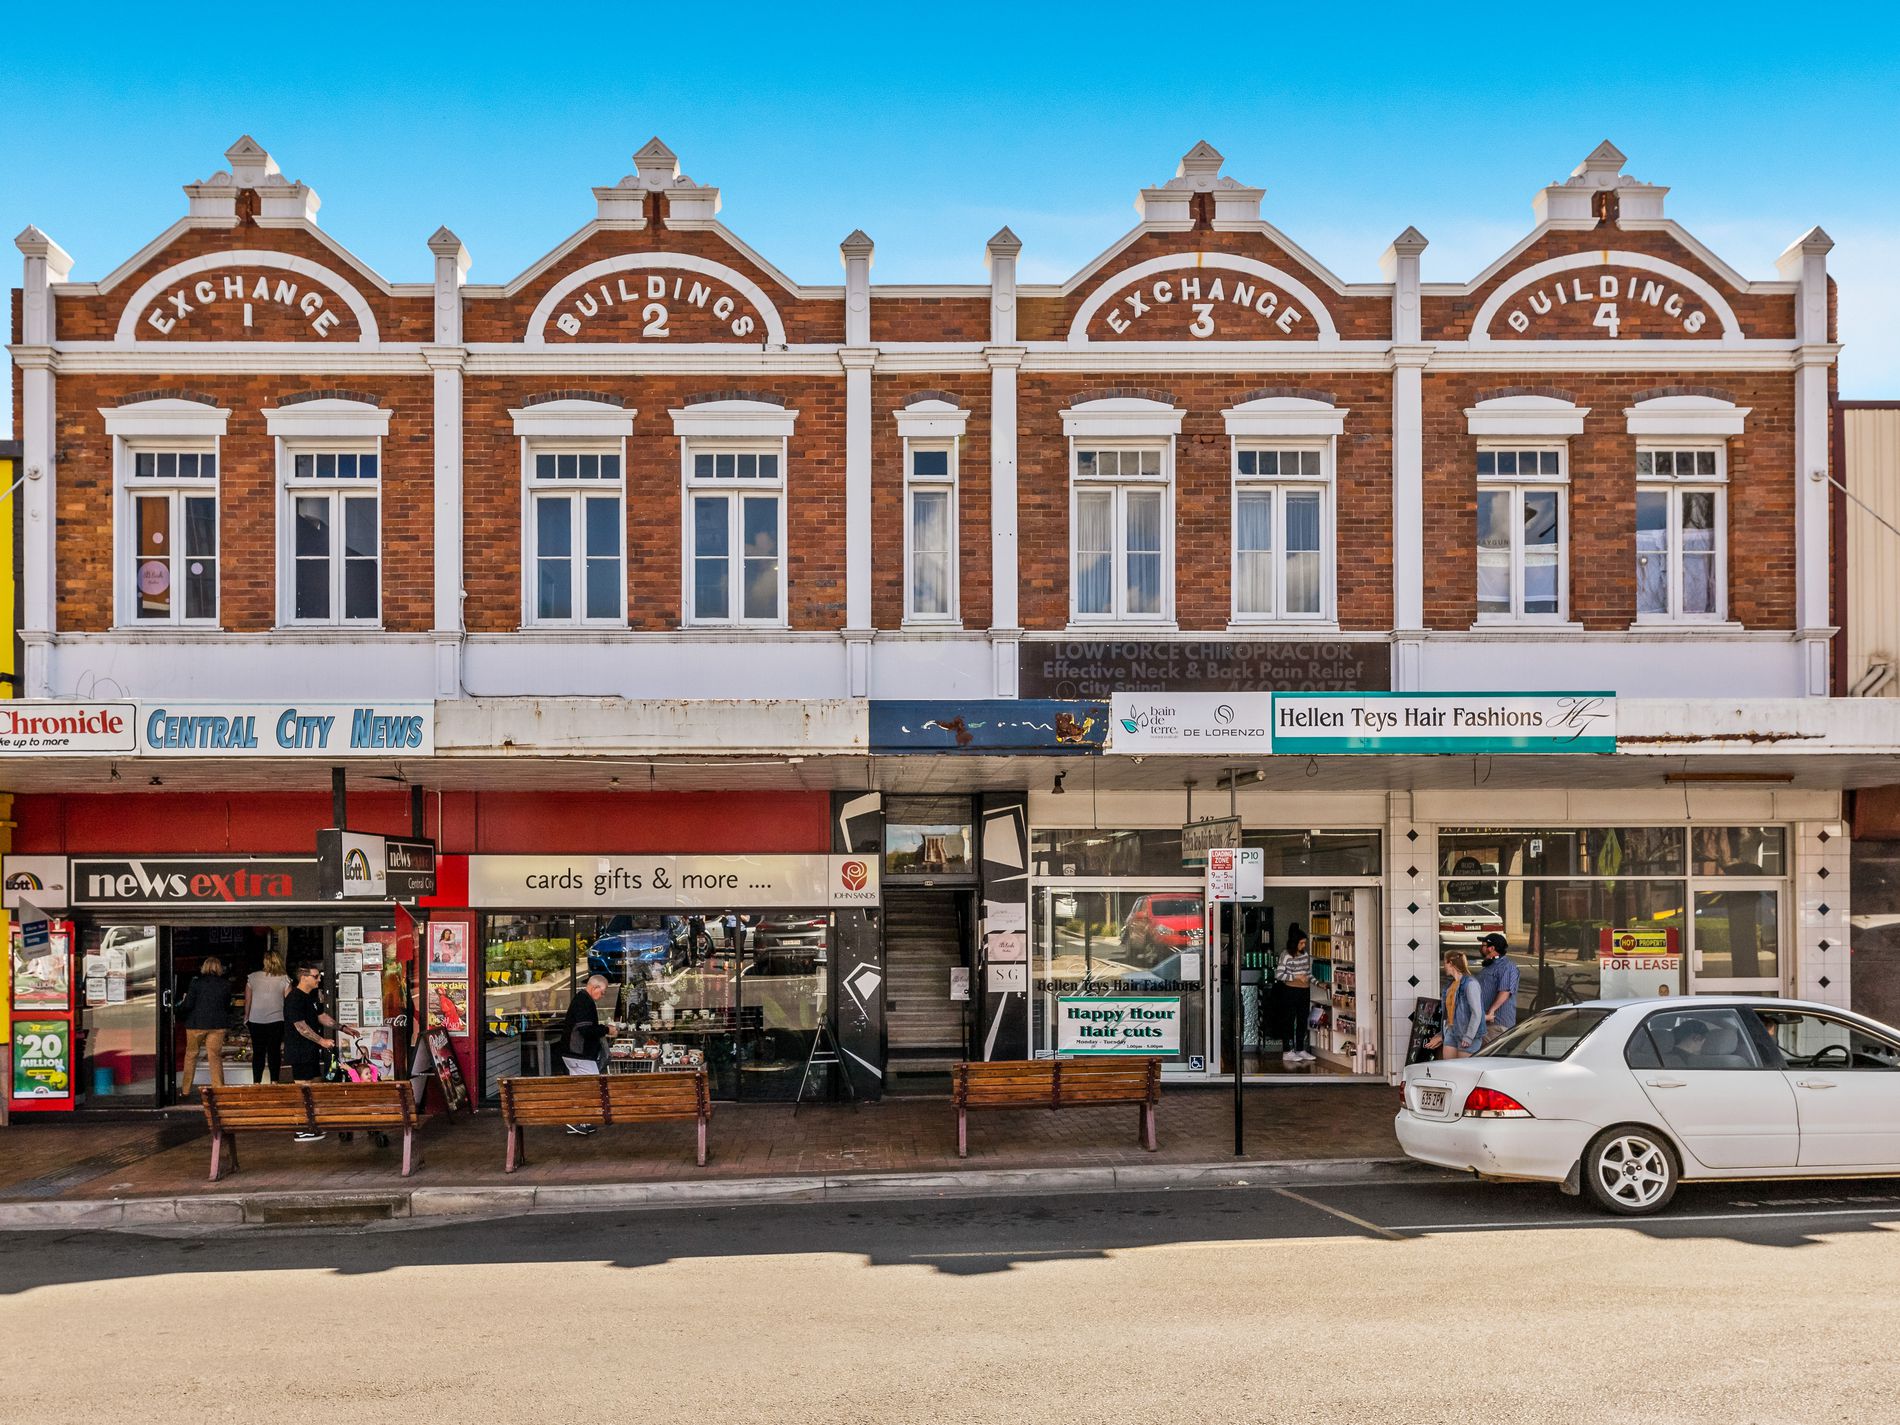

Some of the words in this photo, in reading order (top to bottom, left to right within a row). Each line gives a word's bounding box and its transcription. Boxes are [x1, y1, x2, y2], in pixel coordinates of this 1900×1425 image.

[148, 275, 340, 338] EXCHANGE
[556, 275, 754, 337] BUILDINGS
[1106, 277, 1302, 335] EXCHANGE
[1508, 275, 1706, 334] BUILDINGS
[642, 303, 670, 337] 2
[1189, 303, 1215, 338] 3
[1592, 303, 1620, 337] 4
[1055, 643, 1105, 660] LOW
[1111, 643, 1182, 660] FORCE
[1184, 643, 1354, 660] CHIROPRACTOR
[1043, 661, 1126, 679] Effective
[1132, 662, 1181, 679] Neck
[1185, 662, 1200, 679] &
[1207, 661, 1252, 679] Back
[1260, 661, 1303, 679] Pain
[1308, 660, 1364, 679] Relief
[1150, 706, 1176, 716] bain
[1280, 707, 1344, 728] Hellen
[1351, 707, 1398, 732] Teys
[1405, 706, 1447, 728] Hair
[1453, 706, 1543, 728] Fashions
[0, 710, 123, 735] Chronicle
[1150, 716, 1165, 724] de
[1184, 729, 1200, 737] DE
[1205, 729, 1265, 737] LORENZO
[13, 739, 26, 748] up
[30, 738, 39, 746] to
[42, 738, 70, 746] more
[408, 877, 424, 889] Central
[525, 867, 583, 889] cards
[594, 867, 642, 896] gifts
[652, 867, 673, 889] &
[682, 874, 738, 889] more
[1639, 939, 1666, 947] PROPERTY
[1603, 959, 1631, 970] FOR
[1635, 959, 1678, 970] LEASE
[1037, 979, 1078, 992] Hellen
[1082, 979, 1110, 995] Teys
[1113, 979, 1138, 992] Hair
[1067, 1007, 1124, 1022] Happy
[1130, 1007, 1176, 1020] Hour
[1080, 1025, 1119, 1037] Hair
[1123, 1026, 1163, 1037] cuts
[20, 1059, 64, 1068] MILLION
